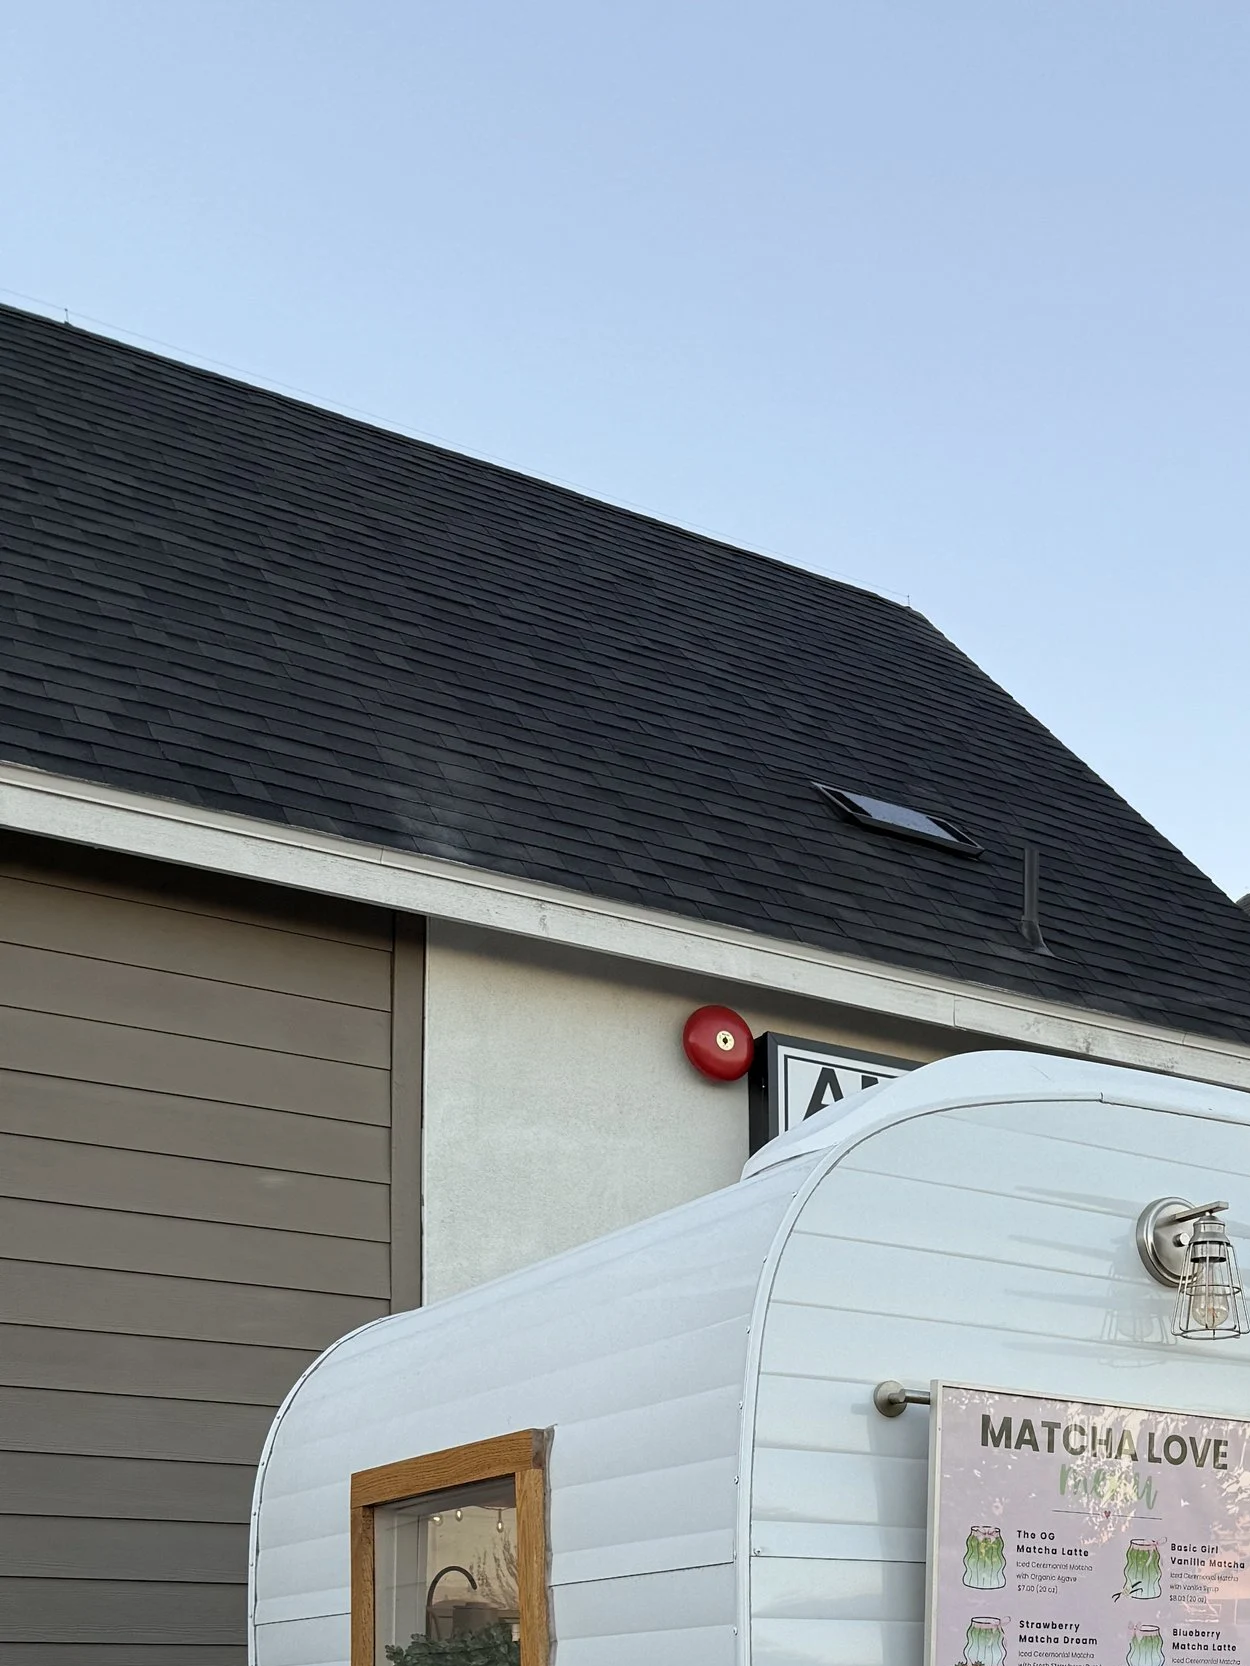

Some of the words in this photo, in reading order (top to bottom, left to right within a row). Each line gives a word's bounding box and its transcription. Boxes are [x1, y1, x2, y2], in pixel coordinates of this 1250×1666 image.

[981, 1414, 1138, 1461] MATCHA
[1147, 1432, 1228, 1470] LOVE
[1017, 1530, 1036, 1539] The
[1040, 1532, 1055, 1541] OG
[1016, 1545, 1057, 1555] Matcha
[1061, 1547, 1089, 1557] Latte
[1170, 1543, 1197, 1553] Basic
[1200, 1544, 1219, 1554] Girl
[1170, 1556, 1206, 1567] Vanilla
[1209, 1559, 1245, 1569] Matcha
[1019, 1620, 1080, 1633] Strawberry
[1018, 1634, 1059, 1644] Matcha
[1063, 1635, 1098, 1645] Dream
[1172, 1628, 1221, 1640] Blueberry
[1172, 1642, 1209, 1651] Matcha
[1212, 1643, 1237, 1652] Latte
